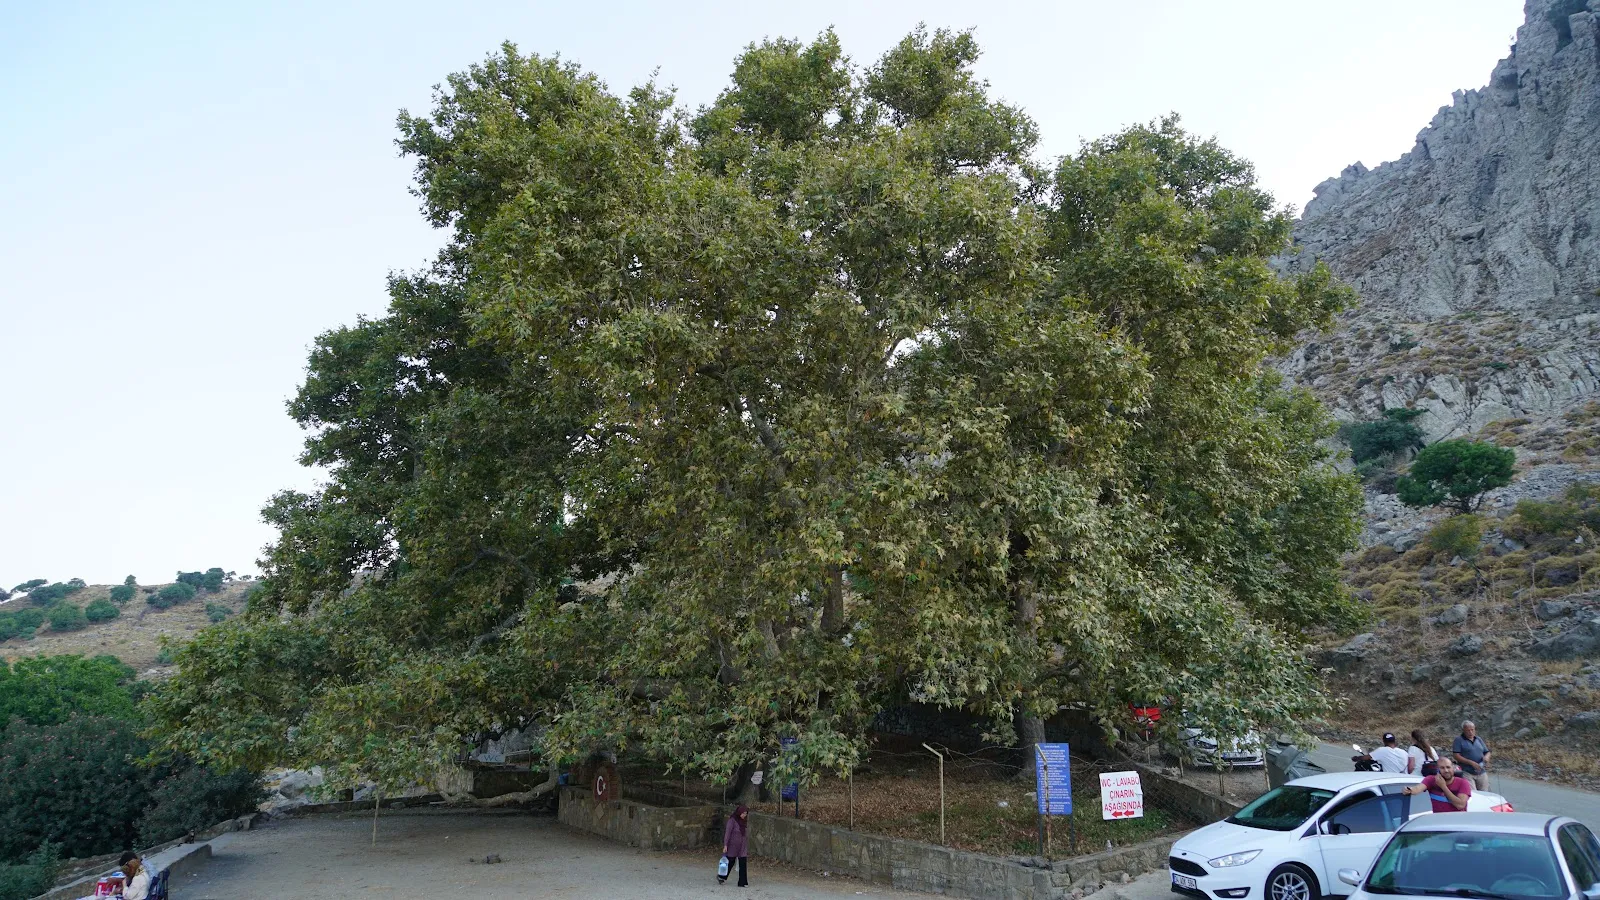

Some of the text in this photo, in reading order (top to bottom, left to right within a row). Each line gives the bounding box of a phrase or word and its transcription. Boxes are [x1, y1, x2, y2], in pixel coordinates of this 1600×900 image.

[1101, 778, 1111, 787] WC
[1116, 776, 1140, 787] LAVABO
[1110, 789, 1134, 800] ÇINARIN
[1104, 800, 1141, 812] AŞAĞISINDA
